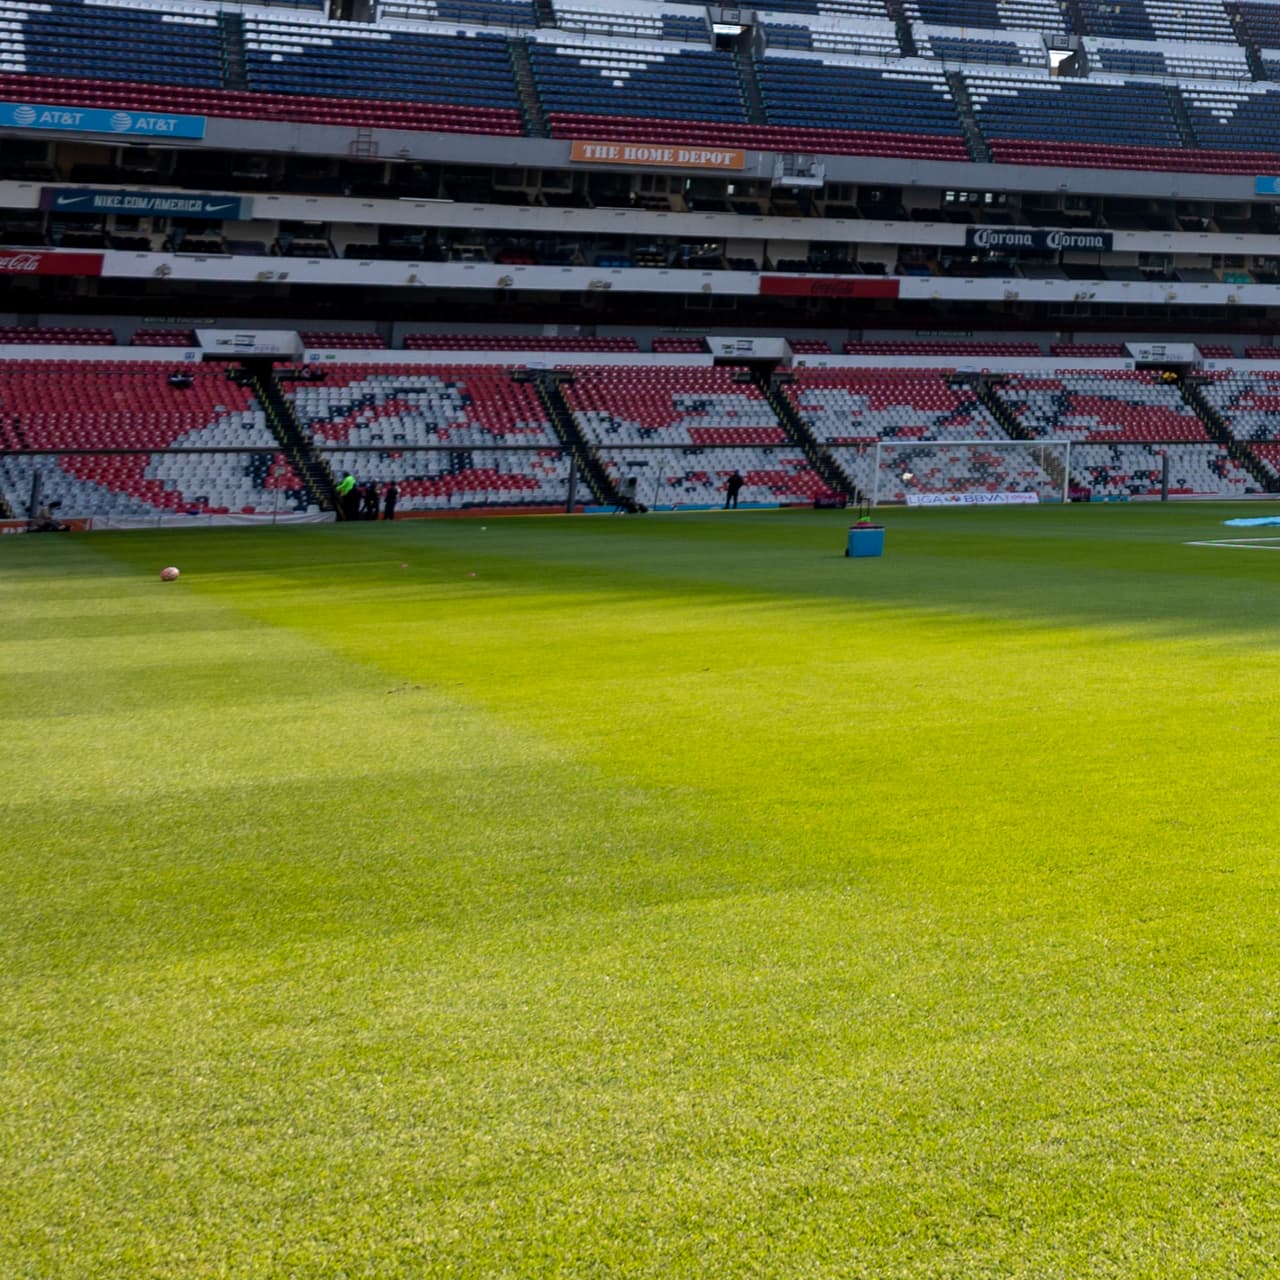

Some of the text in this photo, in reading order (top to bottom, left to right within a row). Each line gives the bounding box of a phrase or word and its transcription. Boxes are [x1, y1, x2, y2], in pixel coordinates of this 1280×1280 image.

[39, 111, 178, 132] AT&T AT&T
[584, 145, 735, 165] THE HOME DEPOT
[94, 195, 203, 212] NIKE.COM/AMERICA
[974, 228, 1103, 249] Corona Corona
[908, 495, 944, 505] LIGA
[963, 494, 1005, 503] BBVA
